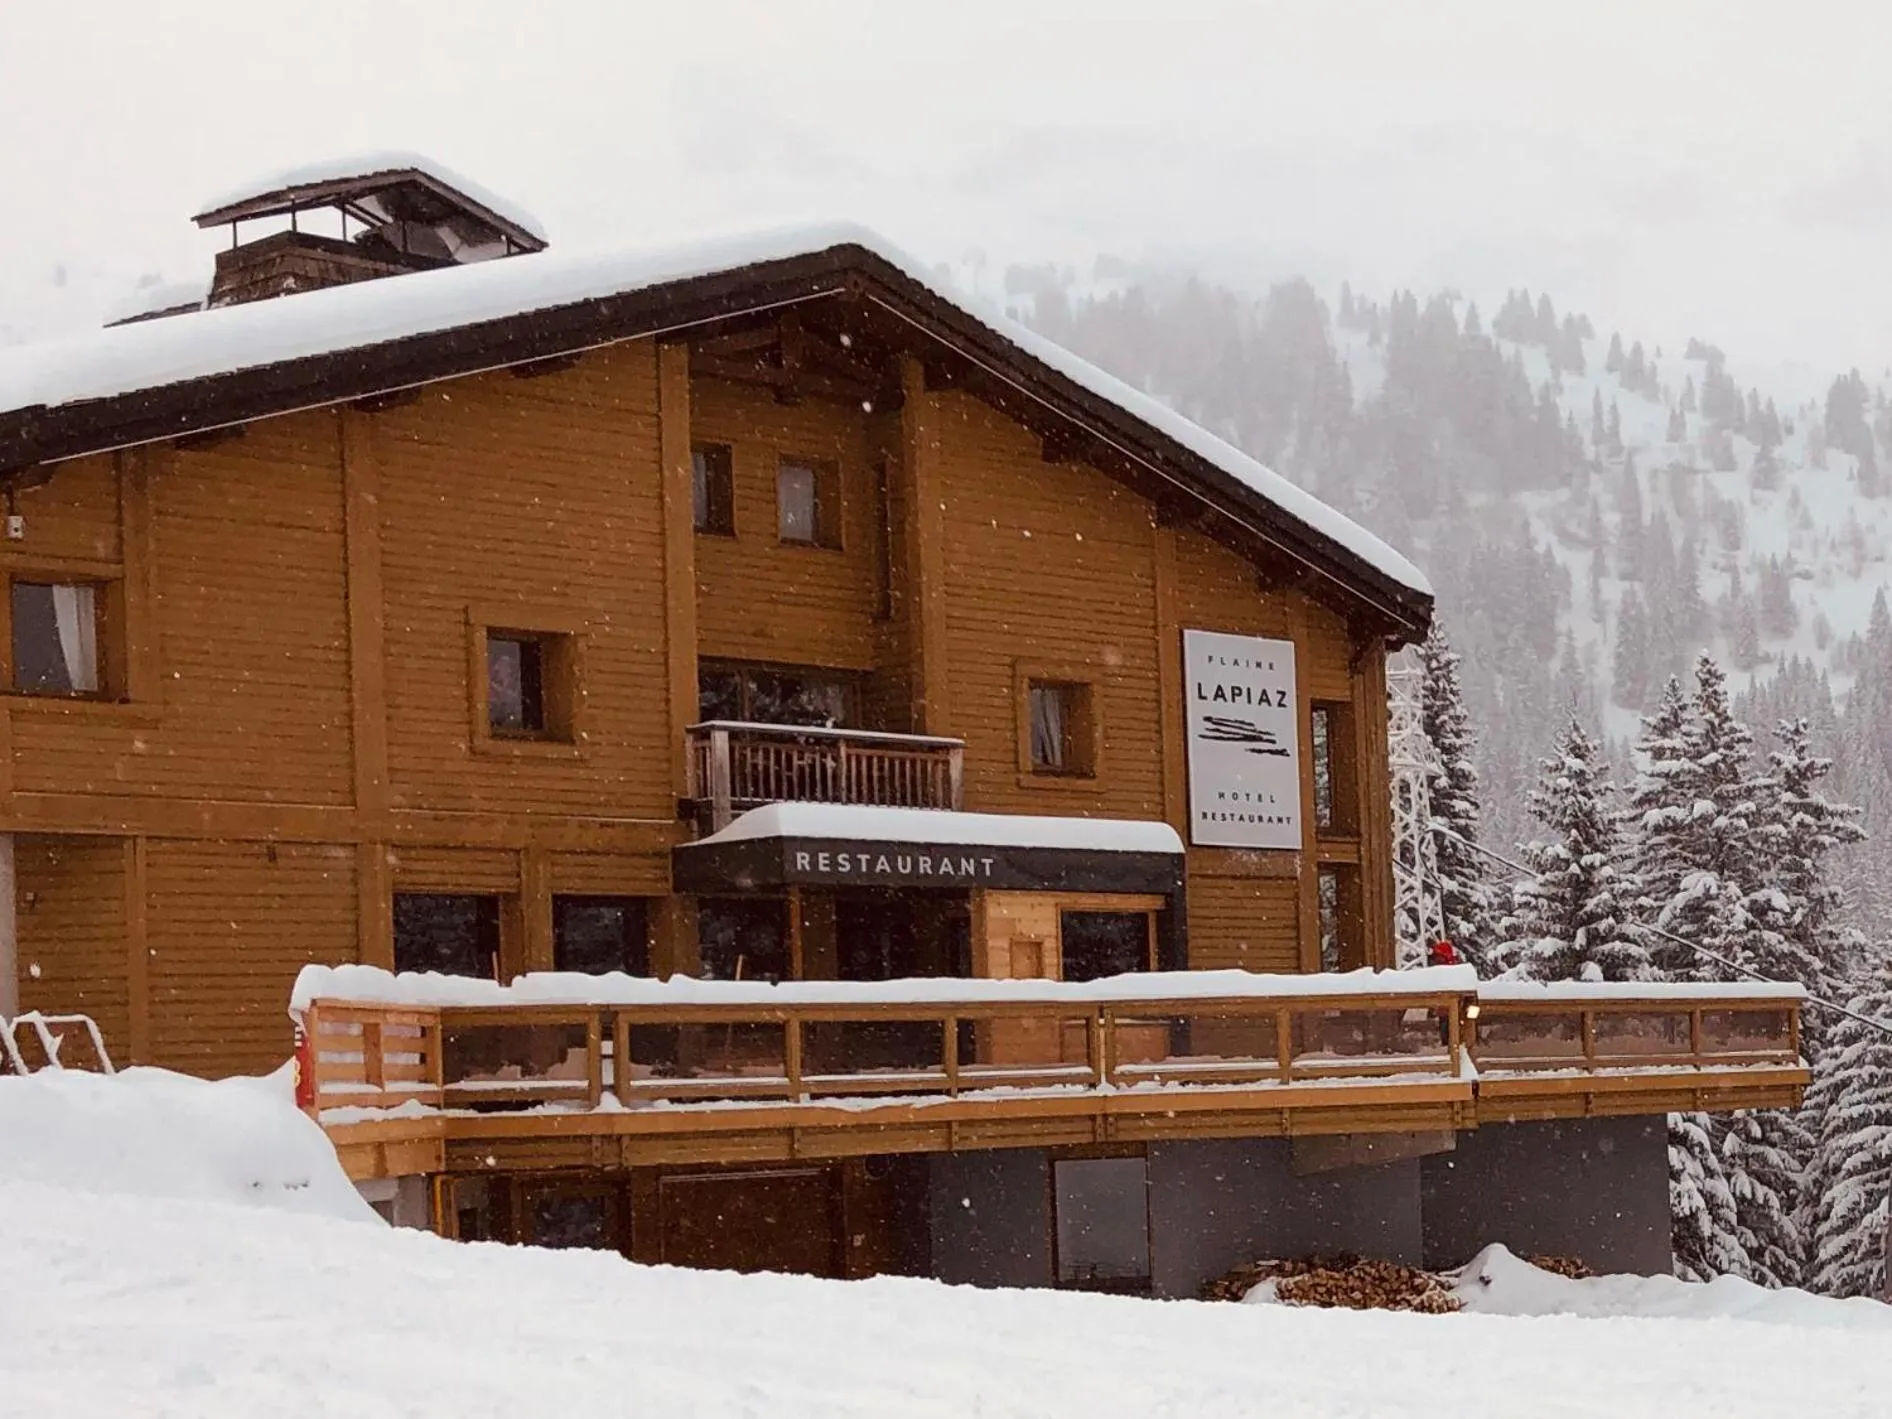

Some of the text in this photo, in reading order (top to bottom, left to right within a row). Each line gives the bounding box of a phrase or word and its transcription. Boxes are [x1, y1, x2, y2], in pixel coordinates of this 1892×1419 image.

[1207, 655, 1275, 671] FLAINE
[1197, 682, 1288, 708] LAPIAZ
[1218, 791, 1275, 804] HOTEL
[1202, 811, 1292, 825] RESTAURANT
[796, 852, 994, 877] RESTAURANT
